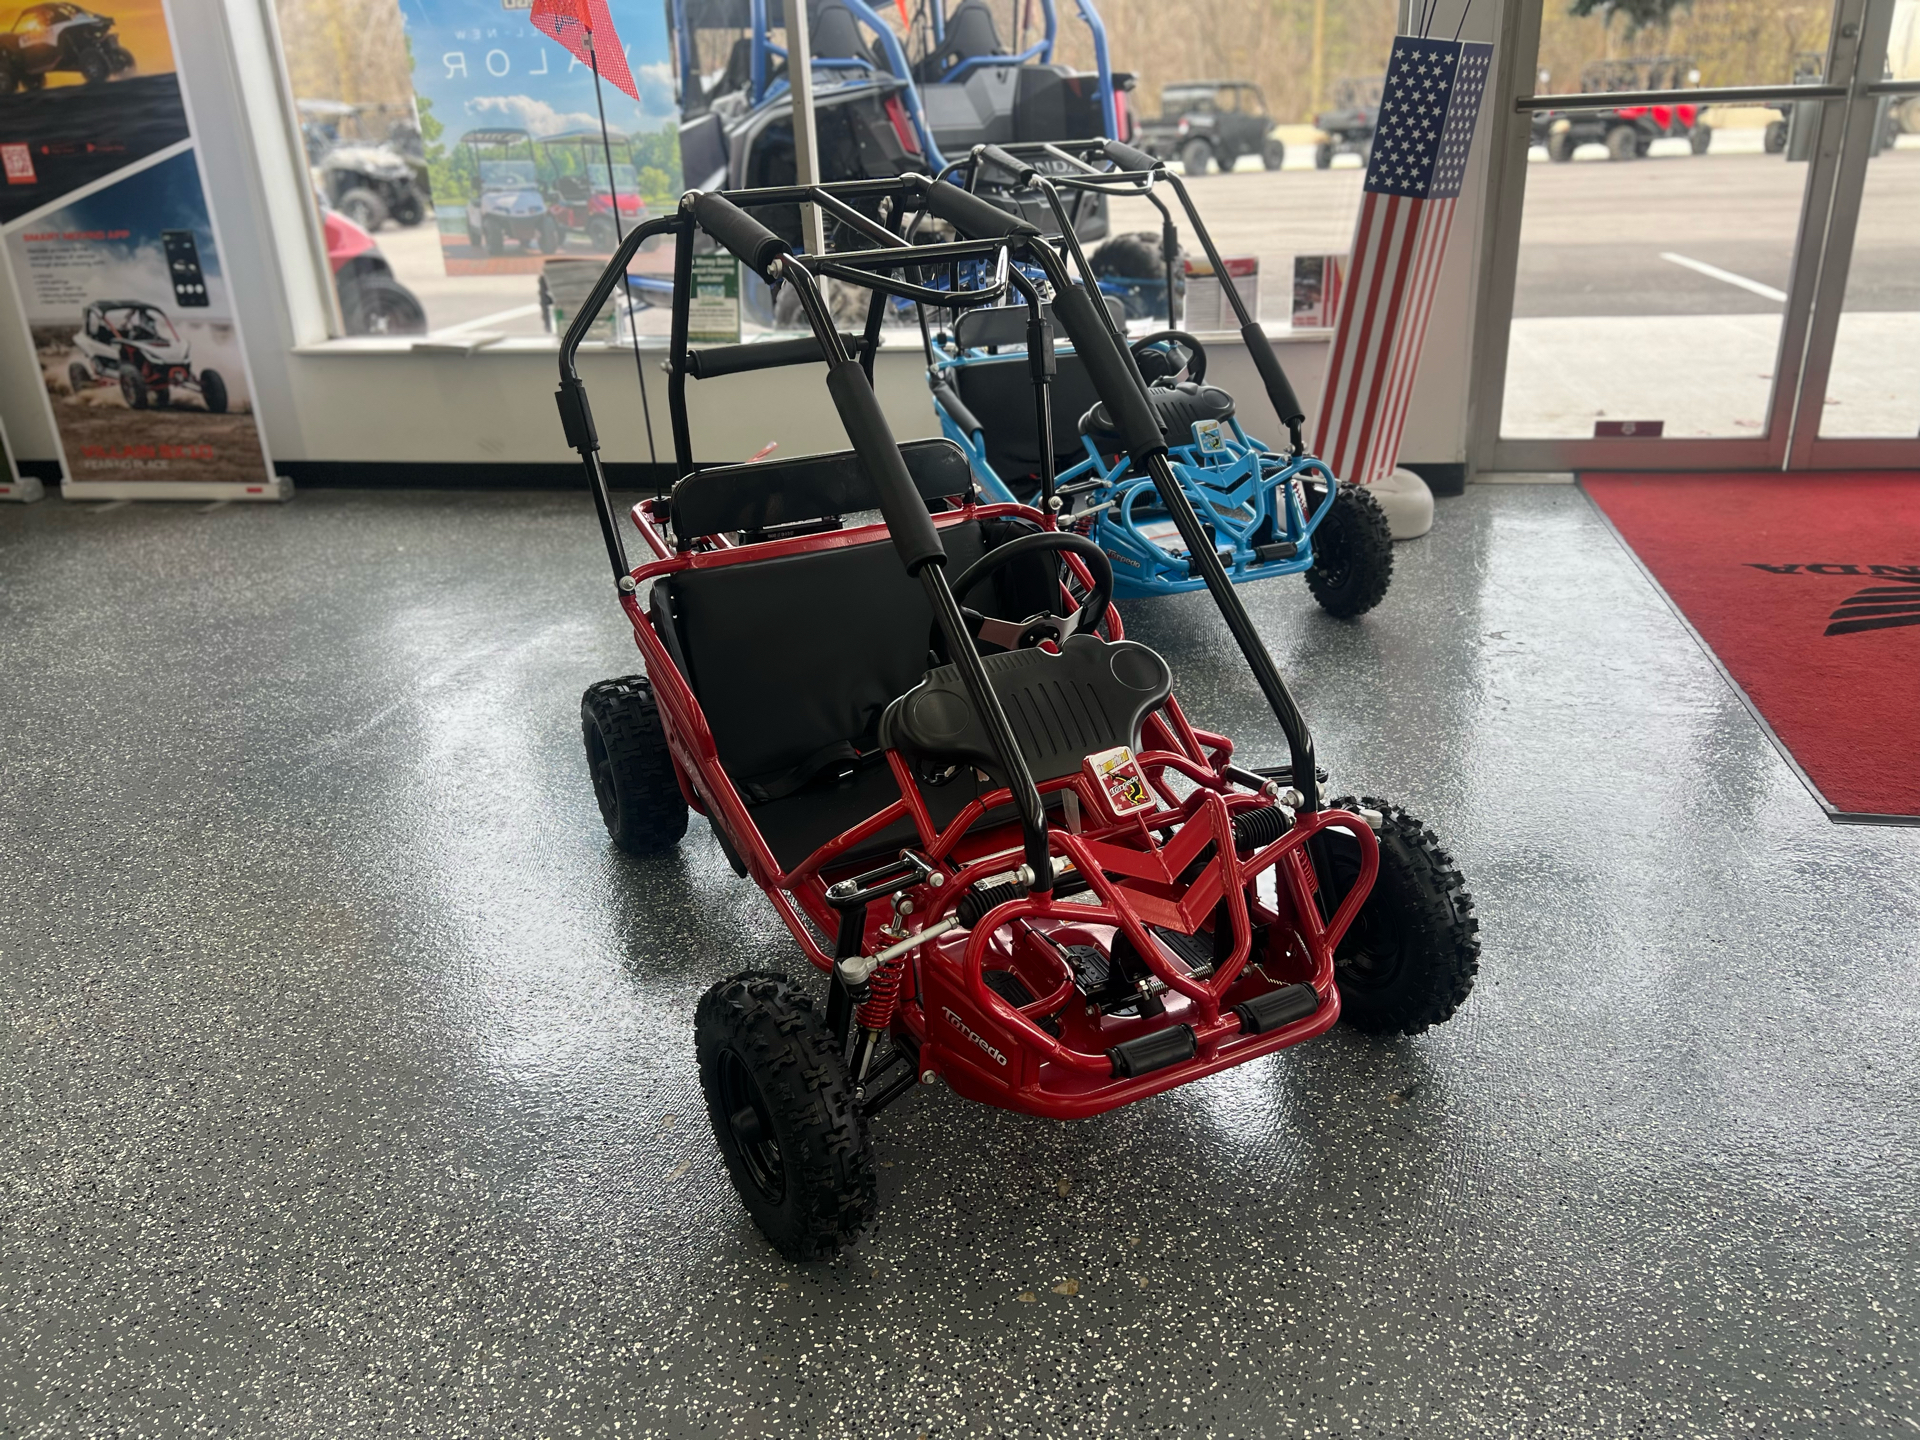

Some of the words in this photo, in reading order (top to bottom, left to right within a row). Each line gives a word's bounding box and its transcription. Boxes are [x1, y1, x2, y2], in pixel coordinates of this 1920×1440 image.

[1107, 548, 1141, 568] Torpedo
[1109, 775, 1139, 796] Torpedo
[941, 1006, 1008, 1067] Torpedo
